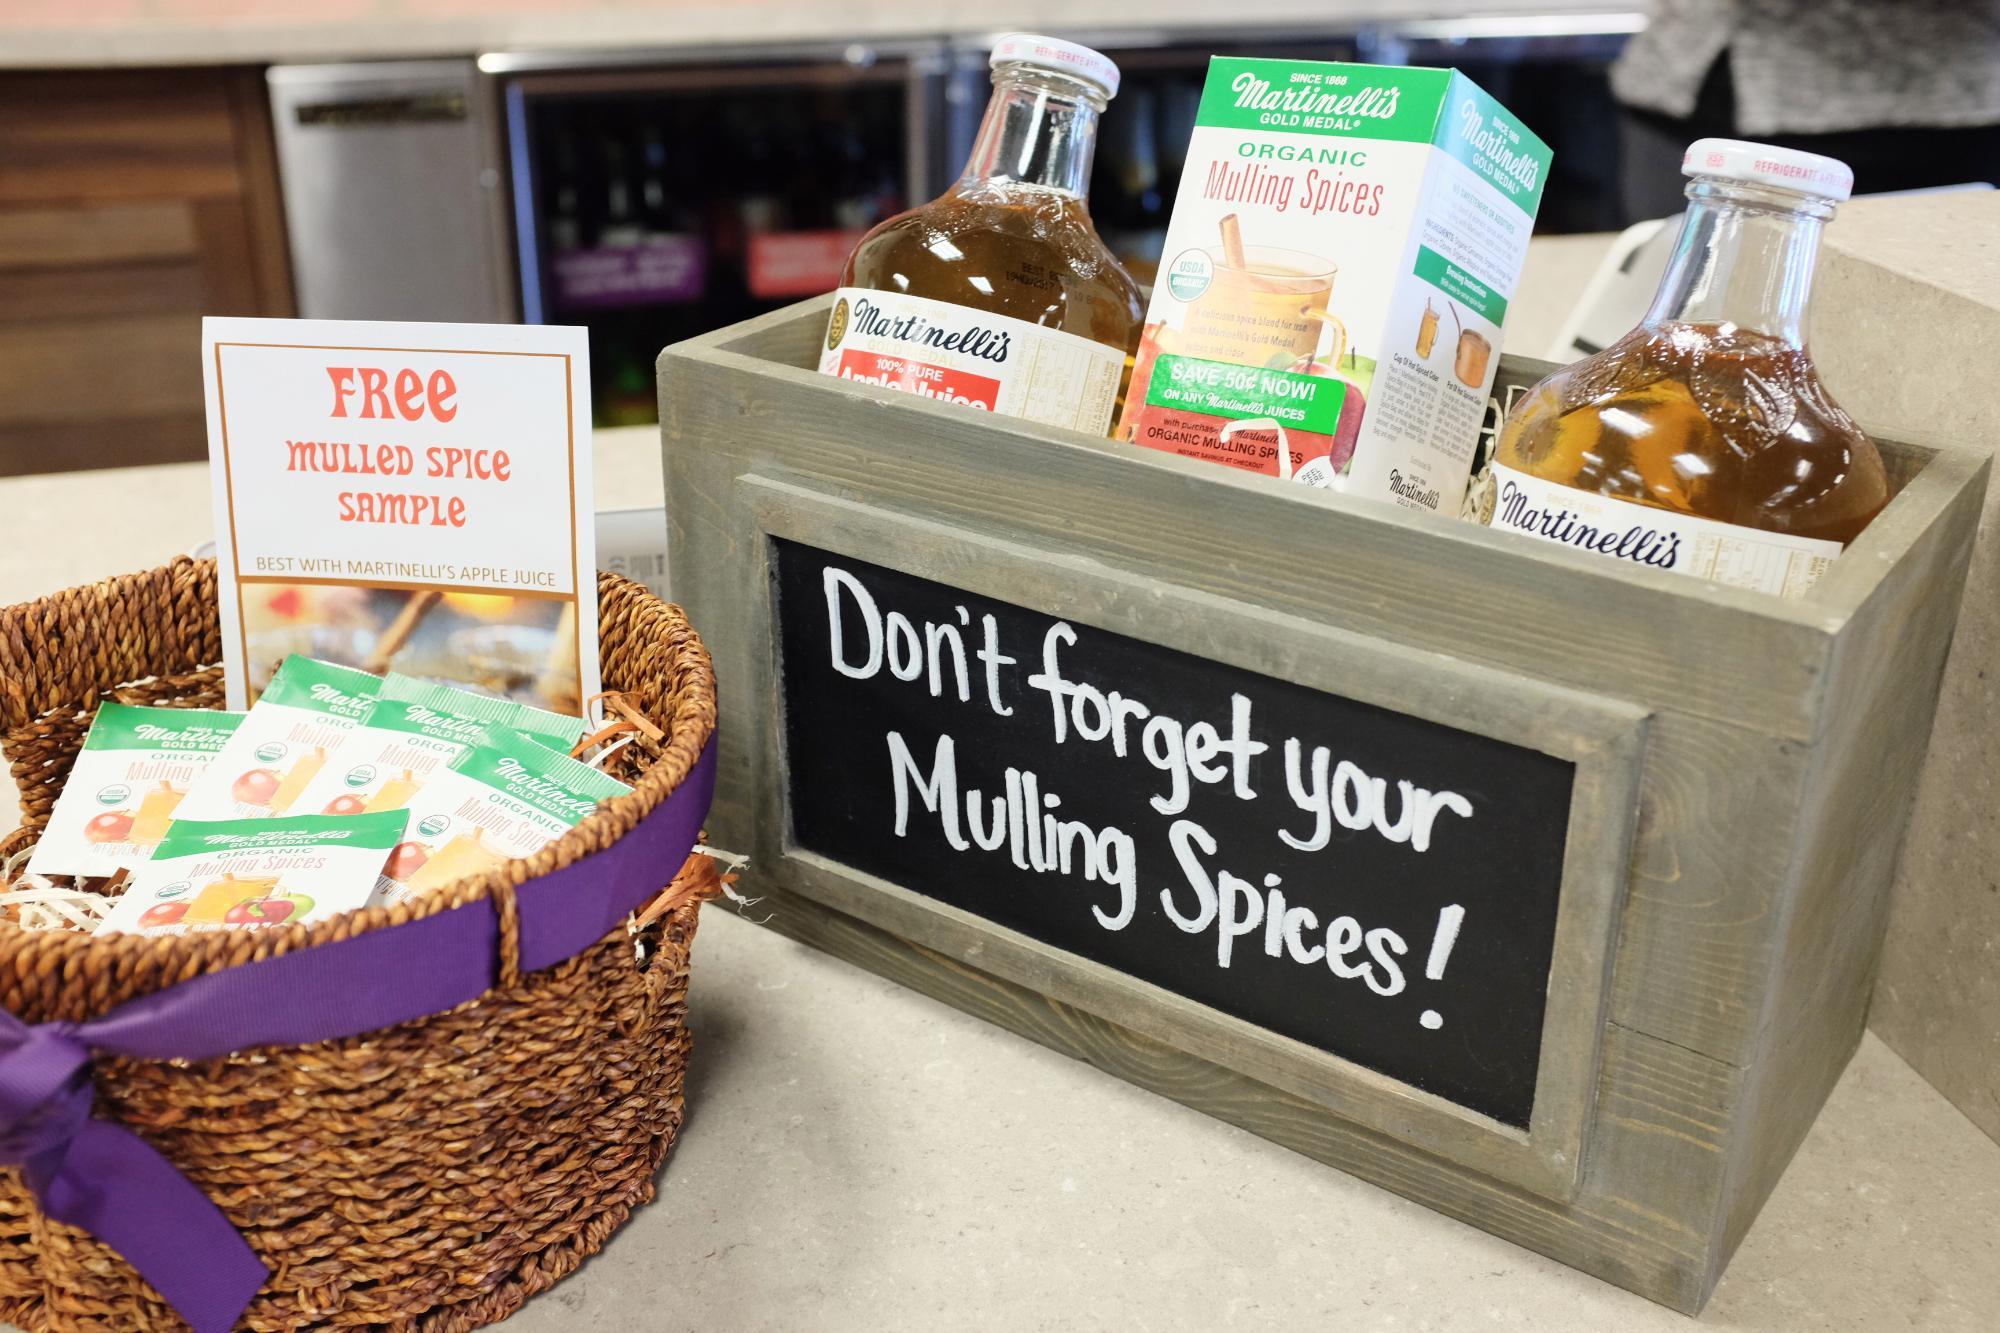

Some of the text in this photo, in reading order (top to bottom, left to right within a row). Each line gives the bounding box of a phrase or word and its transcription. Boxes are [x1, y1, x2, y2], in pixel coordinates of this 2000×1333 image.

[1290, 73, 1323, 84] SINCE
[1231, 72, 1401, 119] Martinelli's
[1260, 113, 1300, 127] GOLD
[1238, 142, 1368, 167] ORGANIC
[1461, 99, 1538, 192] Martinelli's
[1472, 153, 1493, 175] GOLD
[1754, 159, 1818, 181] REFRIGERATE
[1203, 160, 1384, 216] Mulling Spices
[1180, 261, 1204, 274] USDA
[854, 298, 1011, 363] Martinelli's
[1258, 316, 1280, 328] blend
[1281, 319, 1292, 330] for
[1294, 323, 1308, 332] use
[1270, 336, 1296, 349] Medal
[876, 358, 944, 381] 100% PURE
[1171, 362, 1221, 387] SAVE
[1260, 378, 1317, 401] NOW!
[326, 367, 458, 423] FREE
[1163, 388, 1306, 421] ON ANY Martinelli's JUICES
[1163, 418, 1180, 427] with
[1181, 422, 1219, 433] purchas
[1147, 427, 1200, 445] ORGANIC
[1202, 436, 1256, 456] MULLING
[1259, 446, 1303, 464] SPIES
[286, 440, 511, 481] MULLED SPICE
[1232, 459, 1264, 469] CHECKOUT
[1390, 469, 1440, 510] Martinelli's
[338, 492, 466, 527] SAMPLE
[1502, 480, 1681, 568] Martinelli's
[257, 556, 557, 587] BEST WITH MARTINELLI'S APPLE JUICE
[310, 684, 371, 713] Mart
[329, 703, 359, 717] GOLD
[822, 566, 1474, 852] Don't forget your
[161, 741, 197, 749] GOLD
[421, 726, 452, 740] GOLD
[126, 760, 194, 782] Mulling
[378, 744, 439, 774] Mulling
[506, 783, 535, 802] GOLD
[455, 796, 506, 835] Mulling
[489, 793, 562, 833] ORGANIC
[886, 729, 1137, 931] Mulling
[217, 846, 315, 861] ORGANIC
[229, 840, 266, 849] GOLD
[187, 855, 327, 879] Mulling Spices
